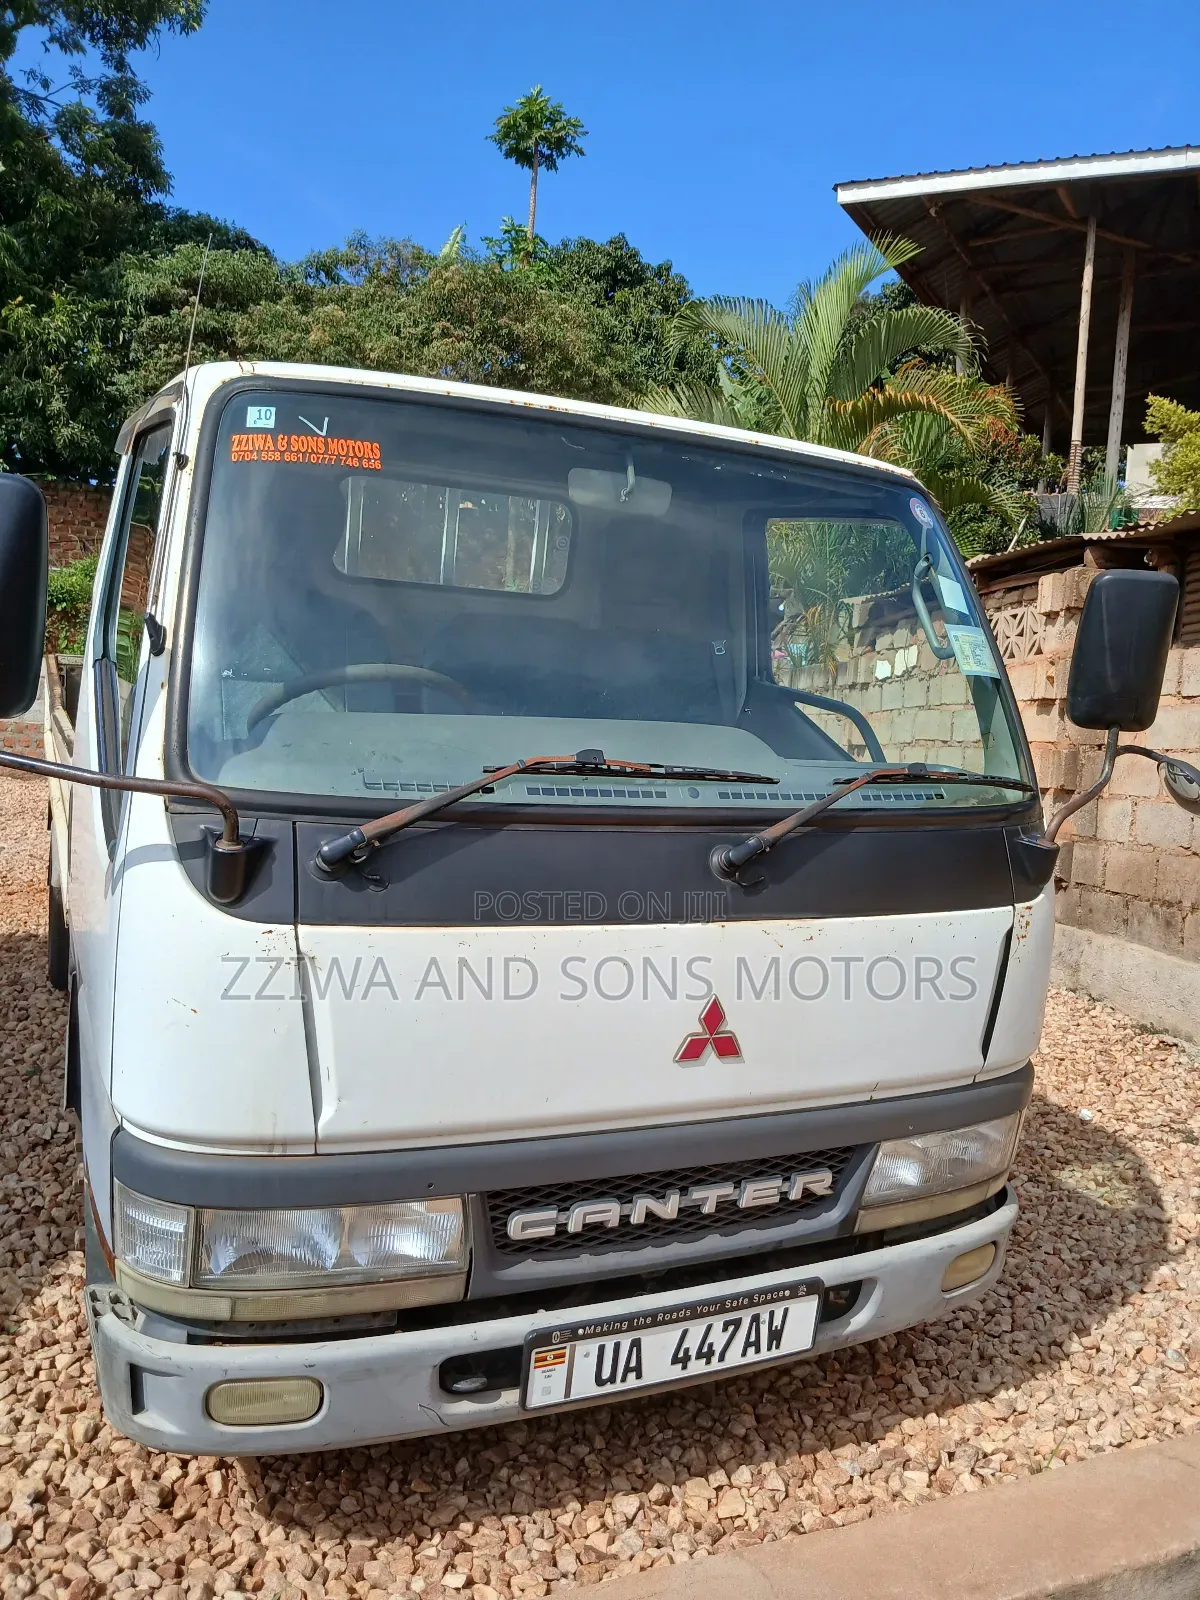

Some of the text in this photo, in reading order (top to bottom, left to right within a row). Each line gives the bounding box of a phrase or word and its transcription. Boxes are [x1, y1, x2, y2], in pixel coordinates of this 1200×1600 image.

[256, 408, 273, 421] 10
[231, 434, 381, 460] ZZIWA & SONS MOTORS
[231, 452, 258, 462] 0704
[261, 452, 281, 461] 558
[340, 456, 359, 467] 746
[507, 1168, 833, 1241] CANTER
[584, 1320, 628, 1335] Making
[633, 1316, 651, 1325] the
[657, 1310, 691, 1321] Roads
[696, 1303, 721, 1314] Your
[725, 1297, 749, 1308] Safe
[753, 1291, 786, 1303] Space
[594, 1306, 790, 1387] UA 447AW
